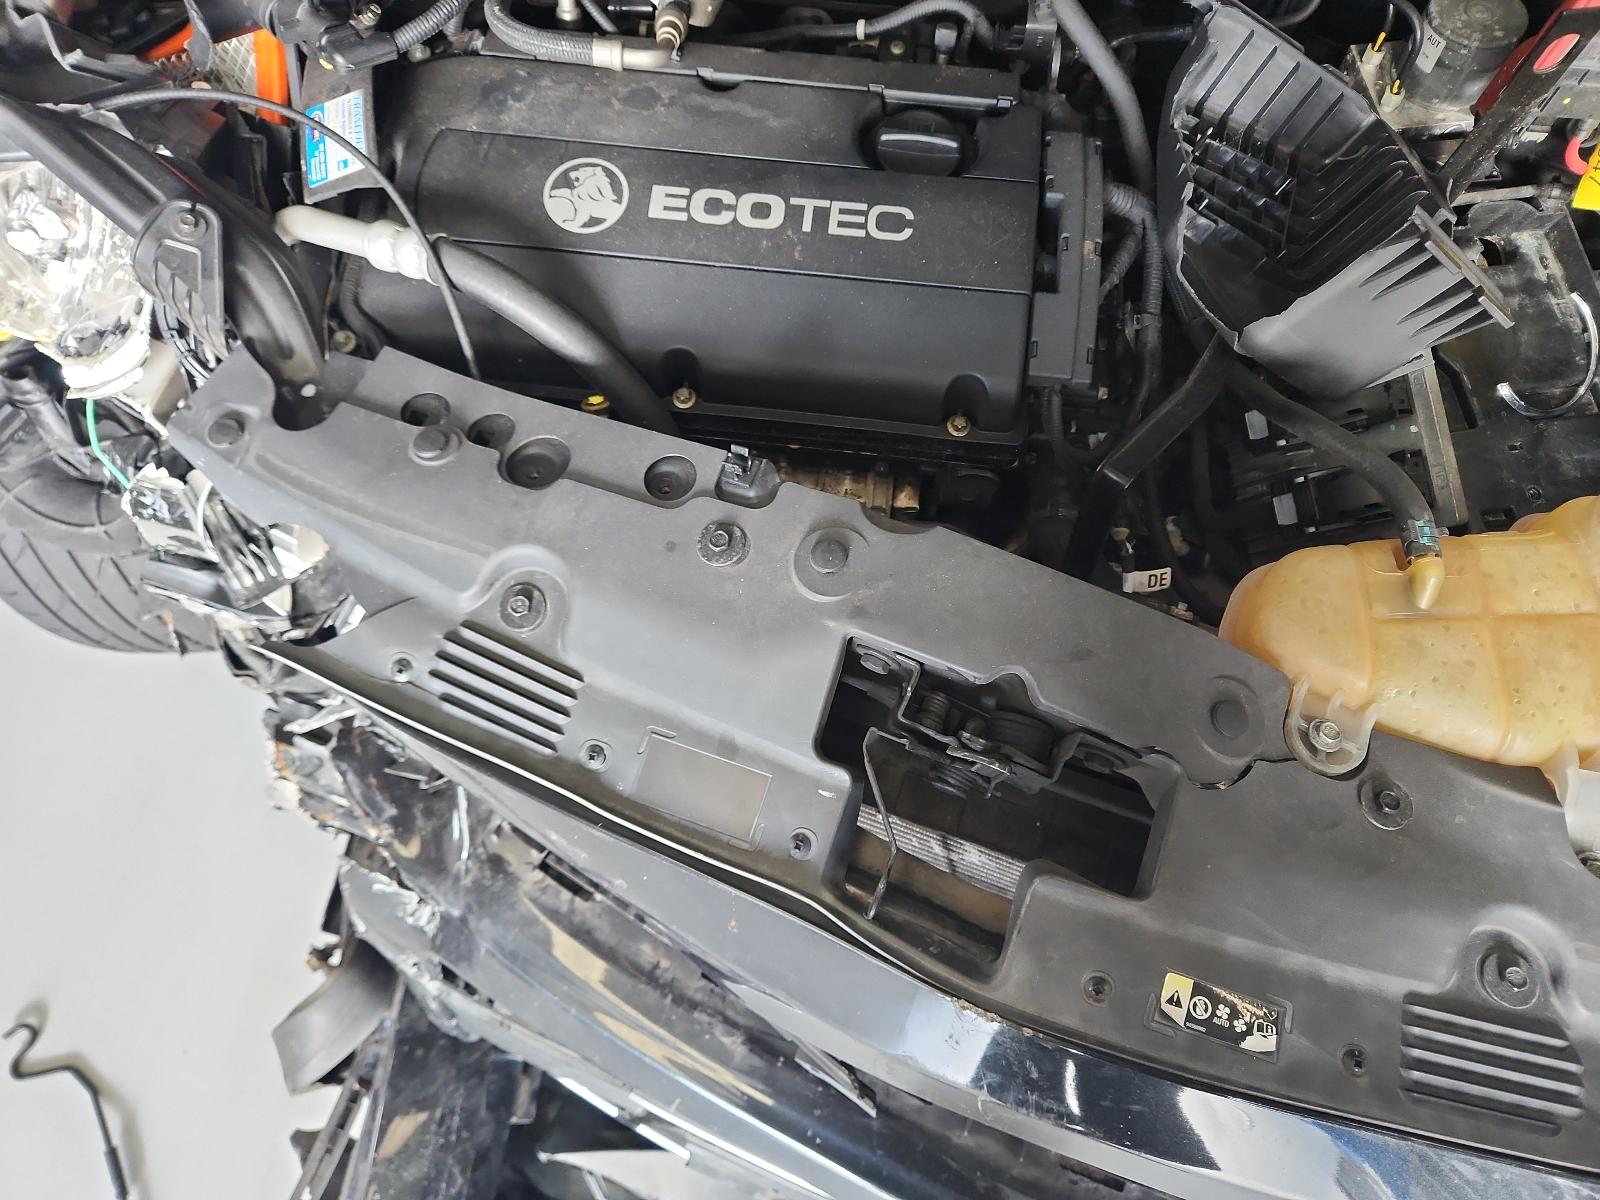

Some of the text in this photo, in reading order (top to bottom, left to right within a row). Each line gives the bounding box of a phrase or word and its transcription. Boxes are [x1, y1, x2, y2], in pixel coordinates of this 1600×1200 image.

[1427, 34, 1441, 49] AUT
[647, 185, 915, 241] ECOTEC
[1147, 572, 1168, 589] DE
[1212, 1016, 1230, 1028] AUTO
